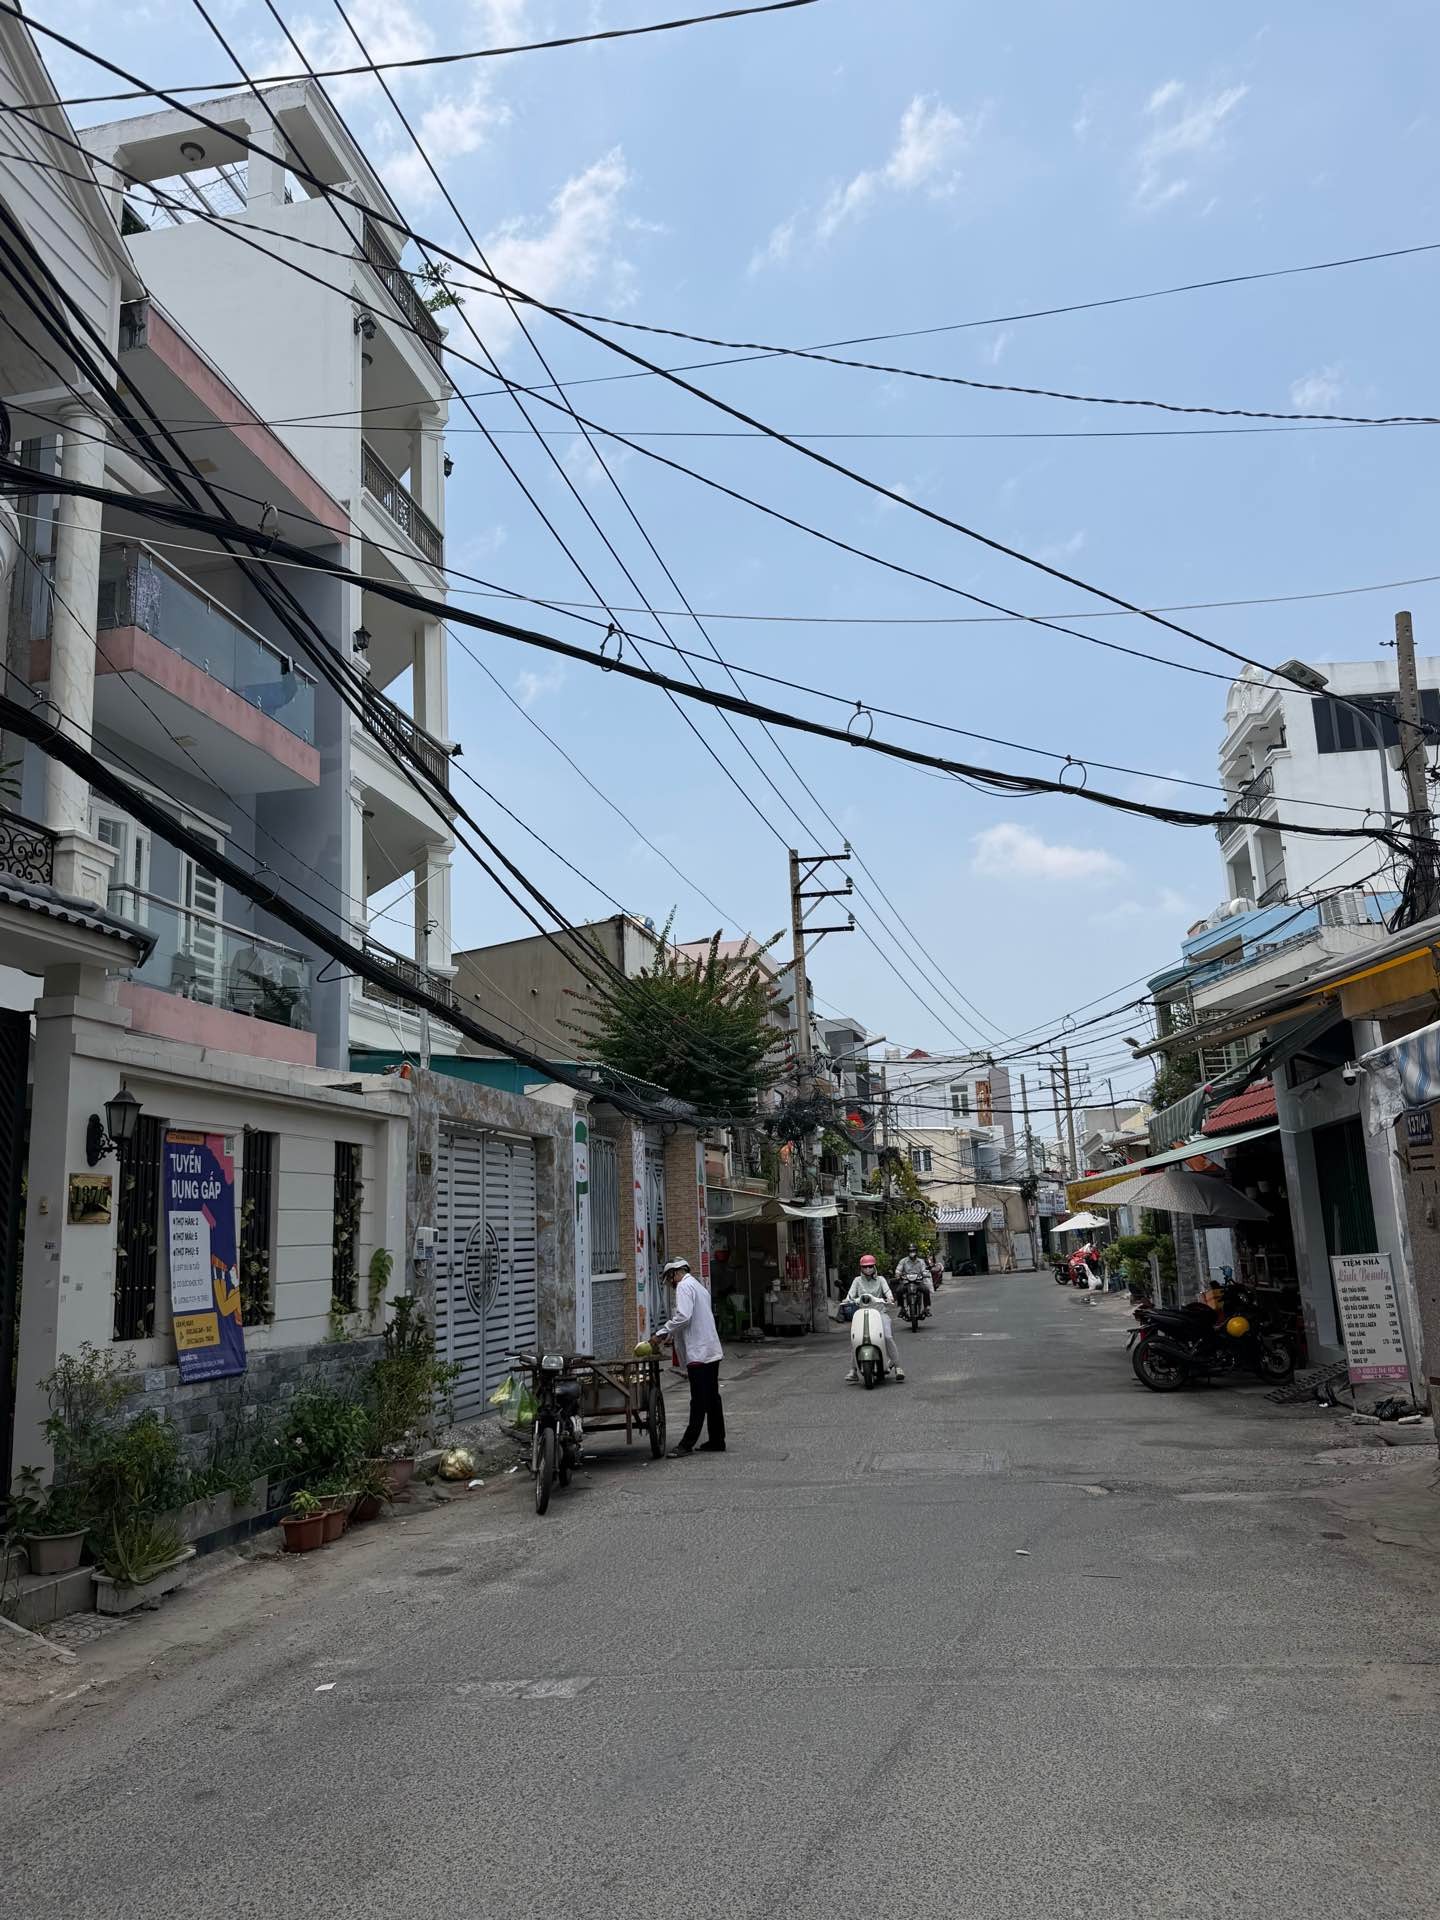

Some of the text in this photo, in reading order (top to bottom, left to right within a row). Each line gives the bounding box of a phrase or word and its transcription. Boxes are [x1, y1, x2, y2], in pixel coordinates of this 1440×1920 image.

[170, 1147, 201, 1174] TUYỂN
[171, 1171, 221, 1204] DỤNG GẤP
[1342, 1258, 1380, 1267] TIỆM NHÀ
